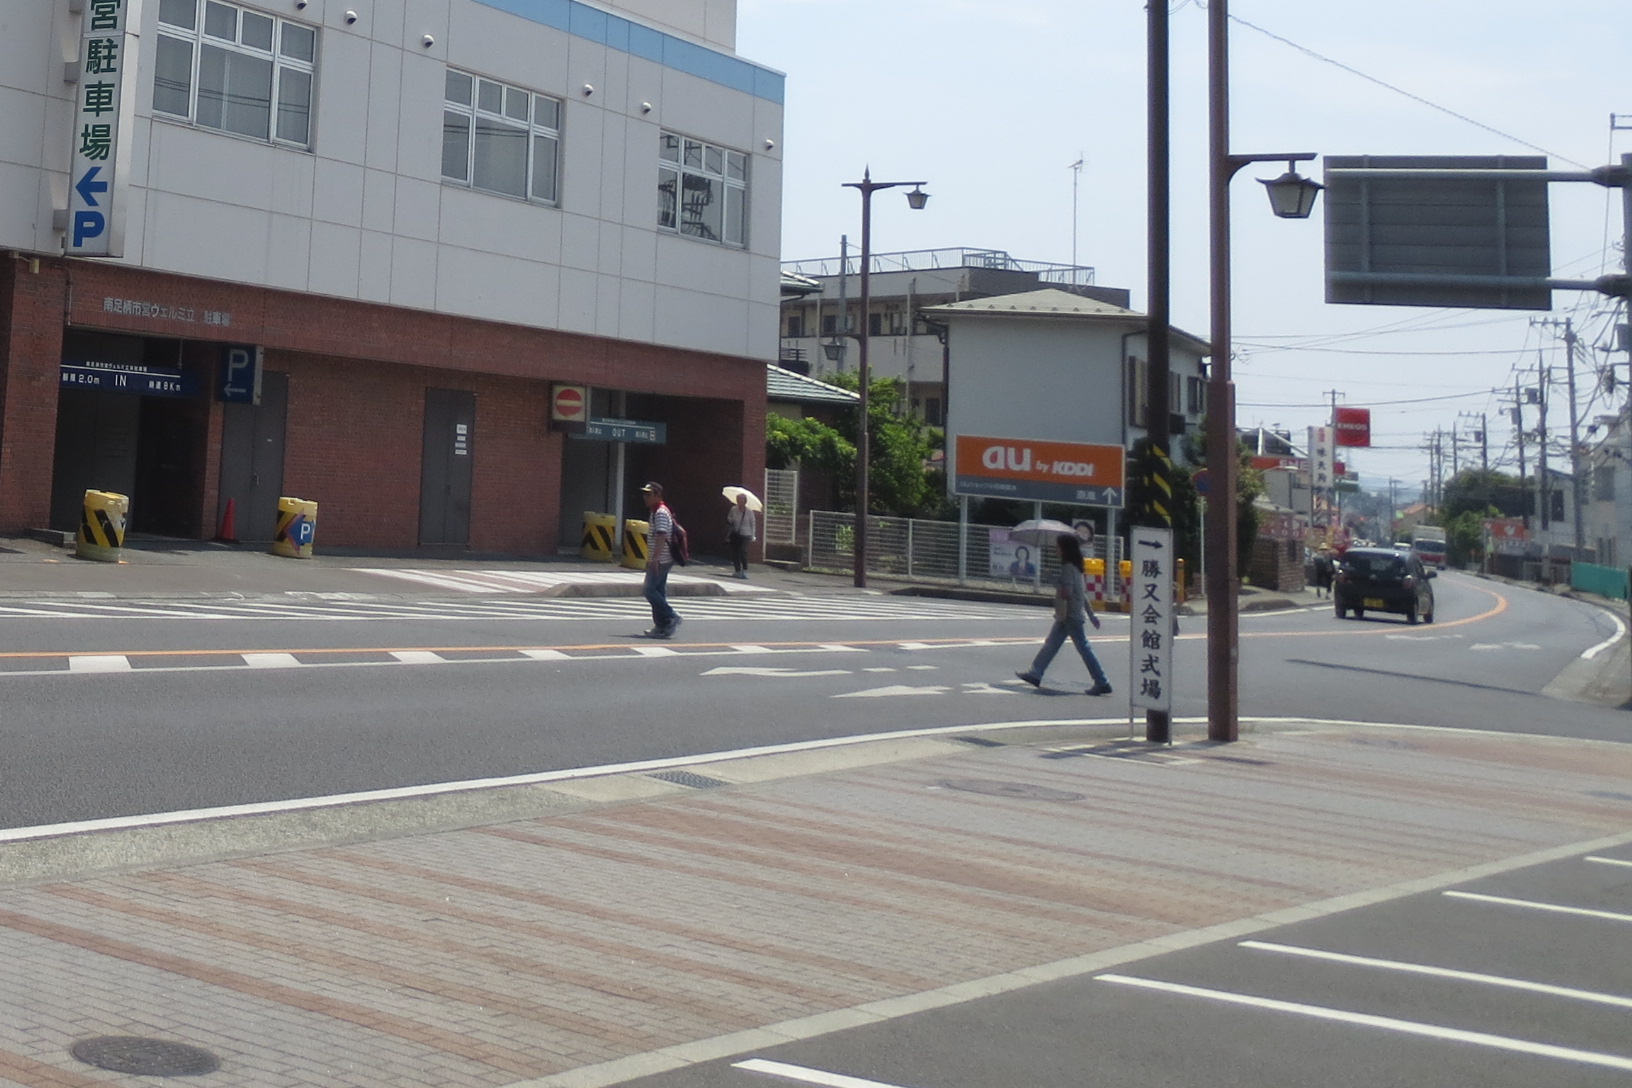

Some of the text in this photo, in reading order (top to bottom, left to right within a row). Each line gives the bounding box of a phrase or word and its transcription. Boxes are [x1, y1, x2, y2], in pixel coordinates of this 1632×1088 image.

[73, 211, 105, 247] P
[228, 348, 249, 382] P
[114, 374, 127, 387] IN
[612, 427, 626, 437] OUT
[1337, 423, 1367, 431] ENEOS
[982, 445, 1094, 477] au by KDDI
[300, 523, 310, 540] P
[1140, 558, 1162, 700] 勝又会館式場
